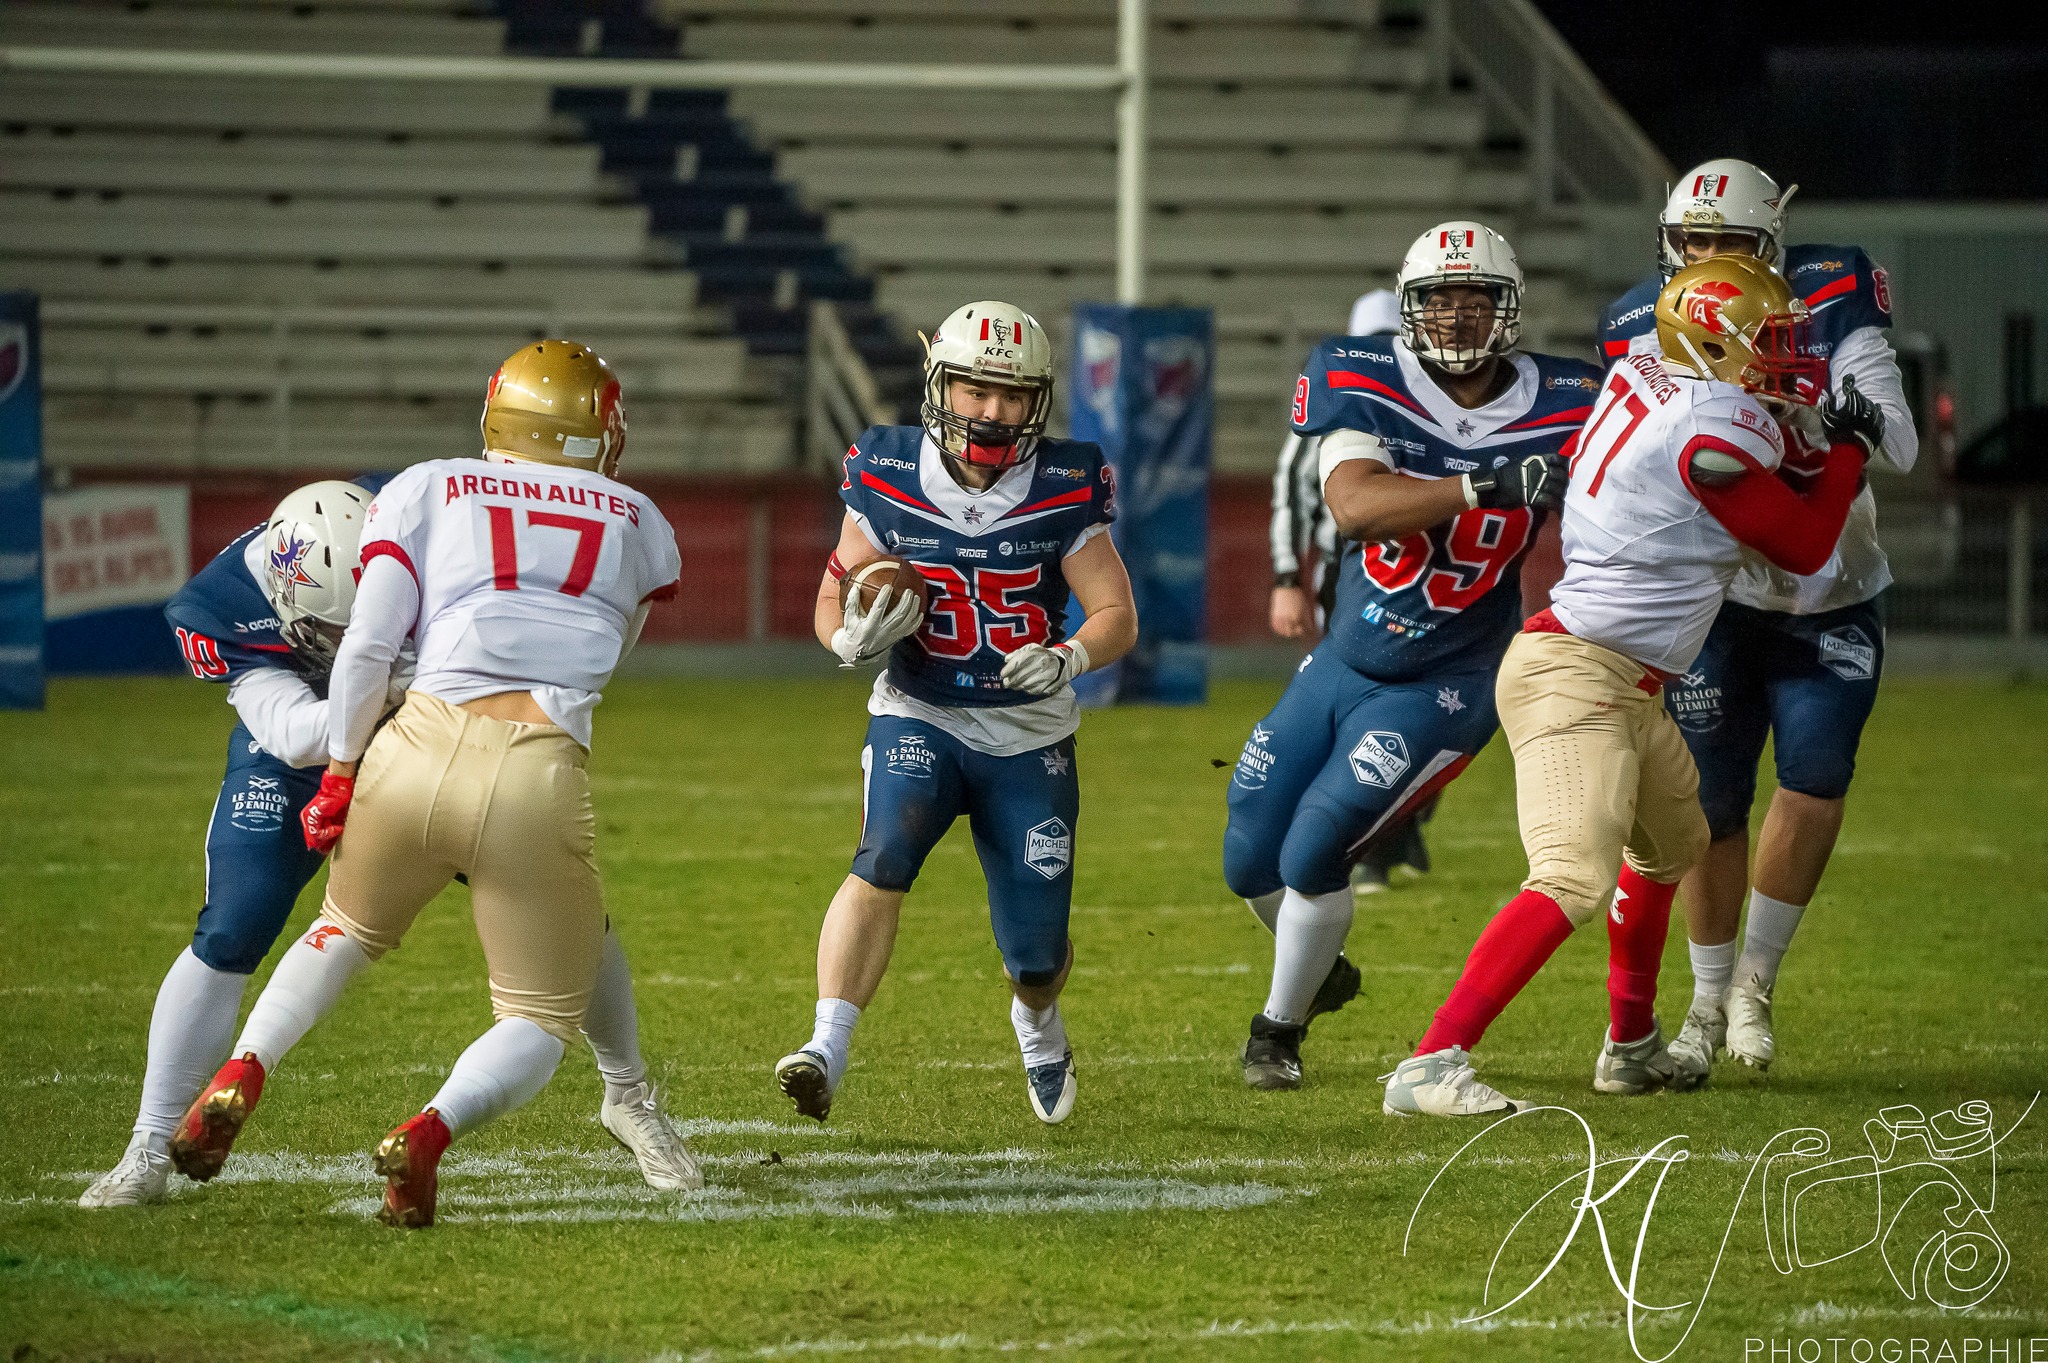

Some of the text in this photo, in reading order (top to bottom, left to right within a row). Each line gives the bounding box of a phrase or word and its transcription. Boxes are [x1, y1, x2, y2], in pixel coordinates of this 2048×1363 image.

[1693, 198, 1718, 208] KFC
[1445, 252, 1471, 260] KFC
[1617, 303, 1656, 327] acqua
[1694, 303, 1709, 325] A
[984, 347, 1014, 358] KFC
[1349, 350, 1394, 363] acqua
[1568, 373, 1651, 498] 77
[879, 458, 917, 471] acqua
[446, 474, 640, 528] ARGONAUTES
[899, 536, 940, 545] TURQUOISE
[1015, 541, 1028, 550] La
[481, 505, 606, 598] 17
[910, 560, 1052, 661] 35
[249, 617, 283, 632] acqu
[176, 627, 230, 679] 10
[1672, 687, 1722, 702] LE SALON
[1676, 699, 1720, 712] D'EMILE
[886, 746, 937, 760] LE SALON
[890, 754, 932, 766] D'EMILE
[232, 791, 290, 807] LE SALON
[234, 800, 284, 814] D'EMILE
